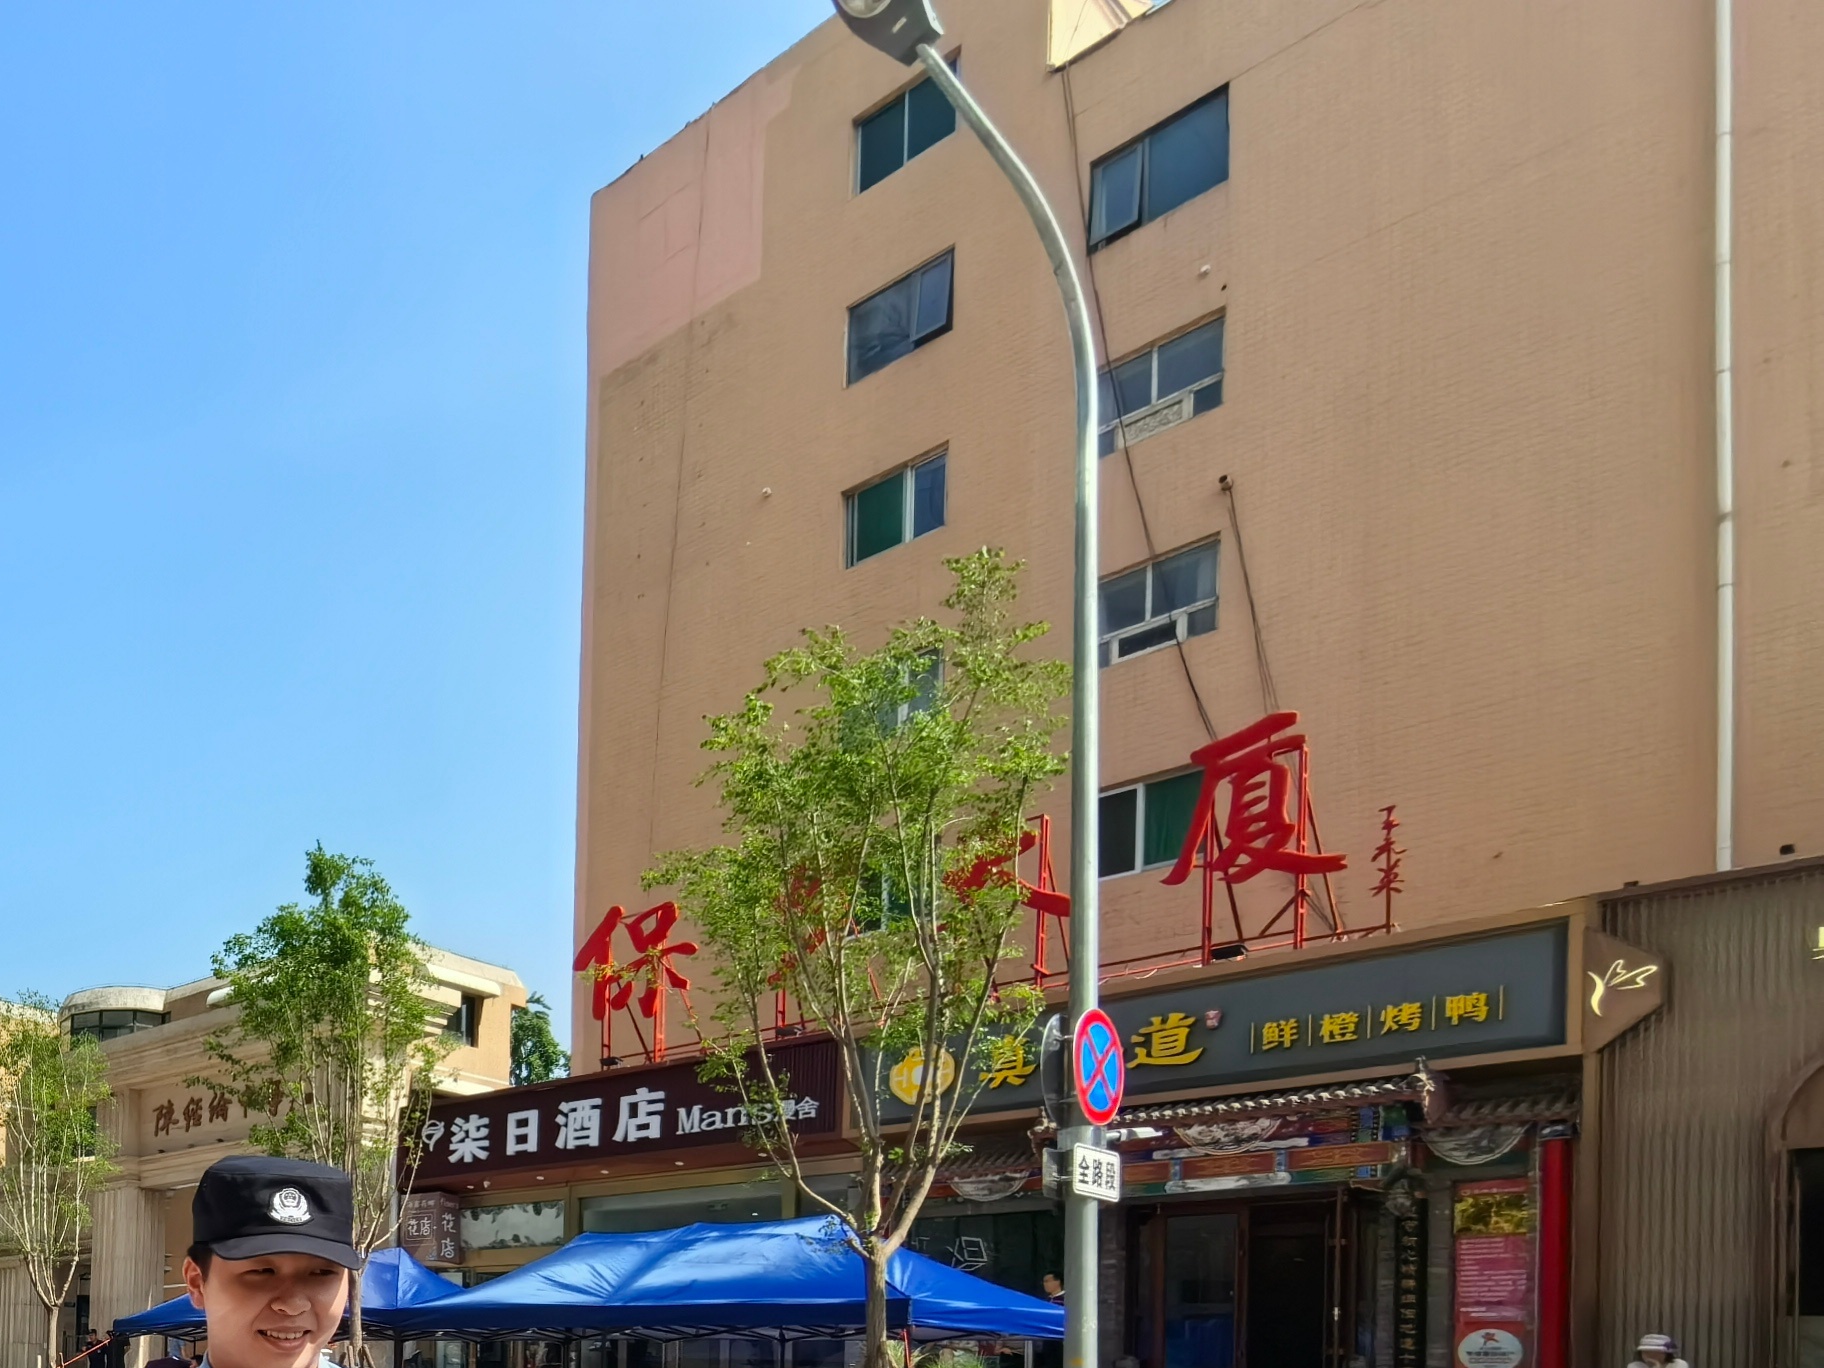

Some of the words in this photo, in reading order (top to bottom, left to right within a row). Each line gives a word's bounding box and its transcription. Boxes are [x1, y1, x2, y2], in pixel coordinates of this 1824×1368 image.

[1261, 990, 1490, 1052] 鲜橙烤鸭
[979, 1011, 1205, 1090] 真道
[447, 1087, 666, 1163] 柒日酒店
[1078, 1154, 1116, 1191] 全路段
[407, 1217, 432, 1236] 花店
[440, 1212, 457, 1259] 花店
